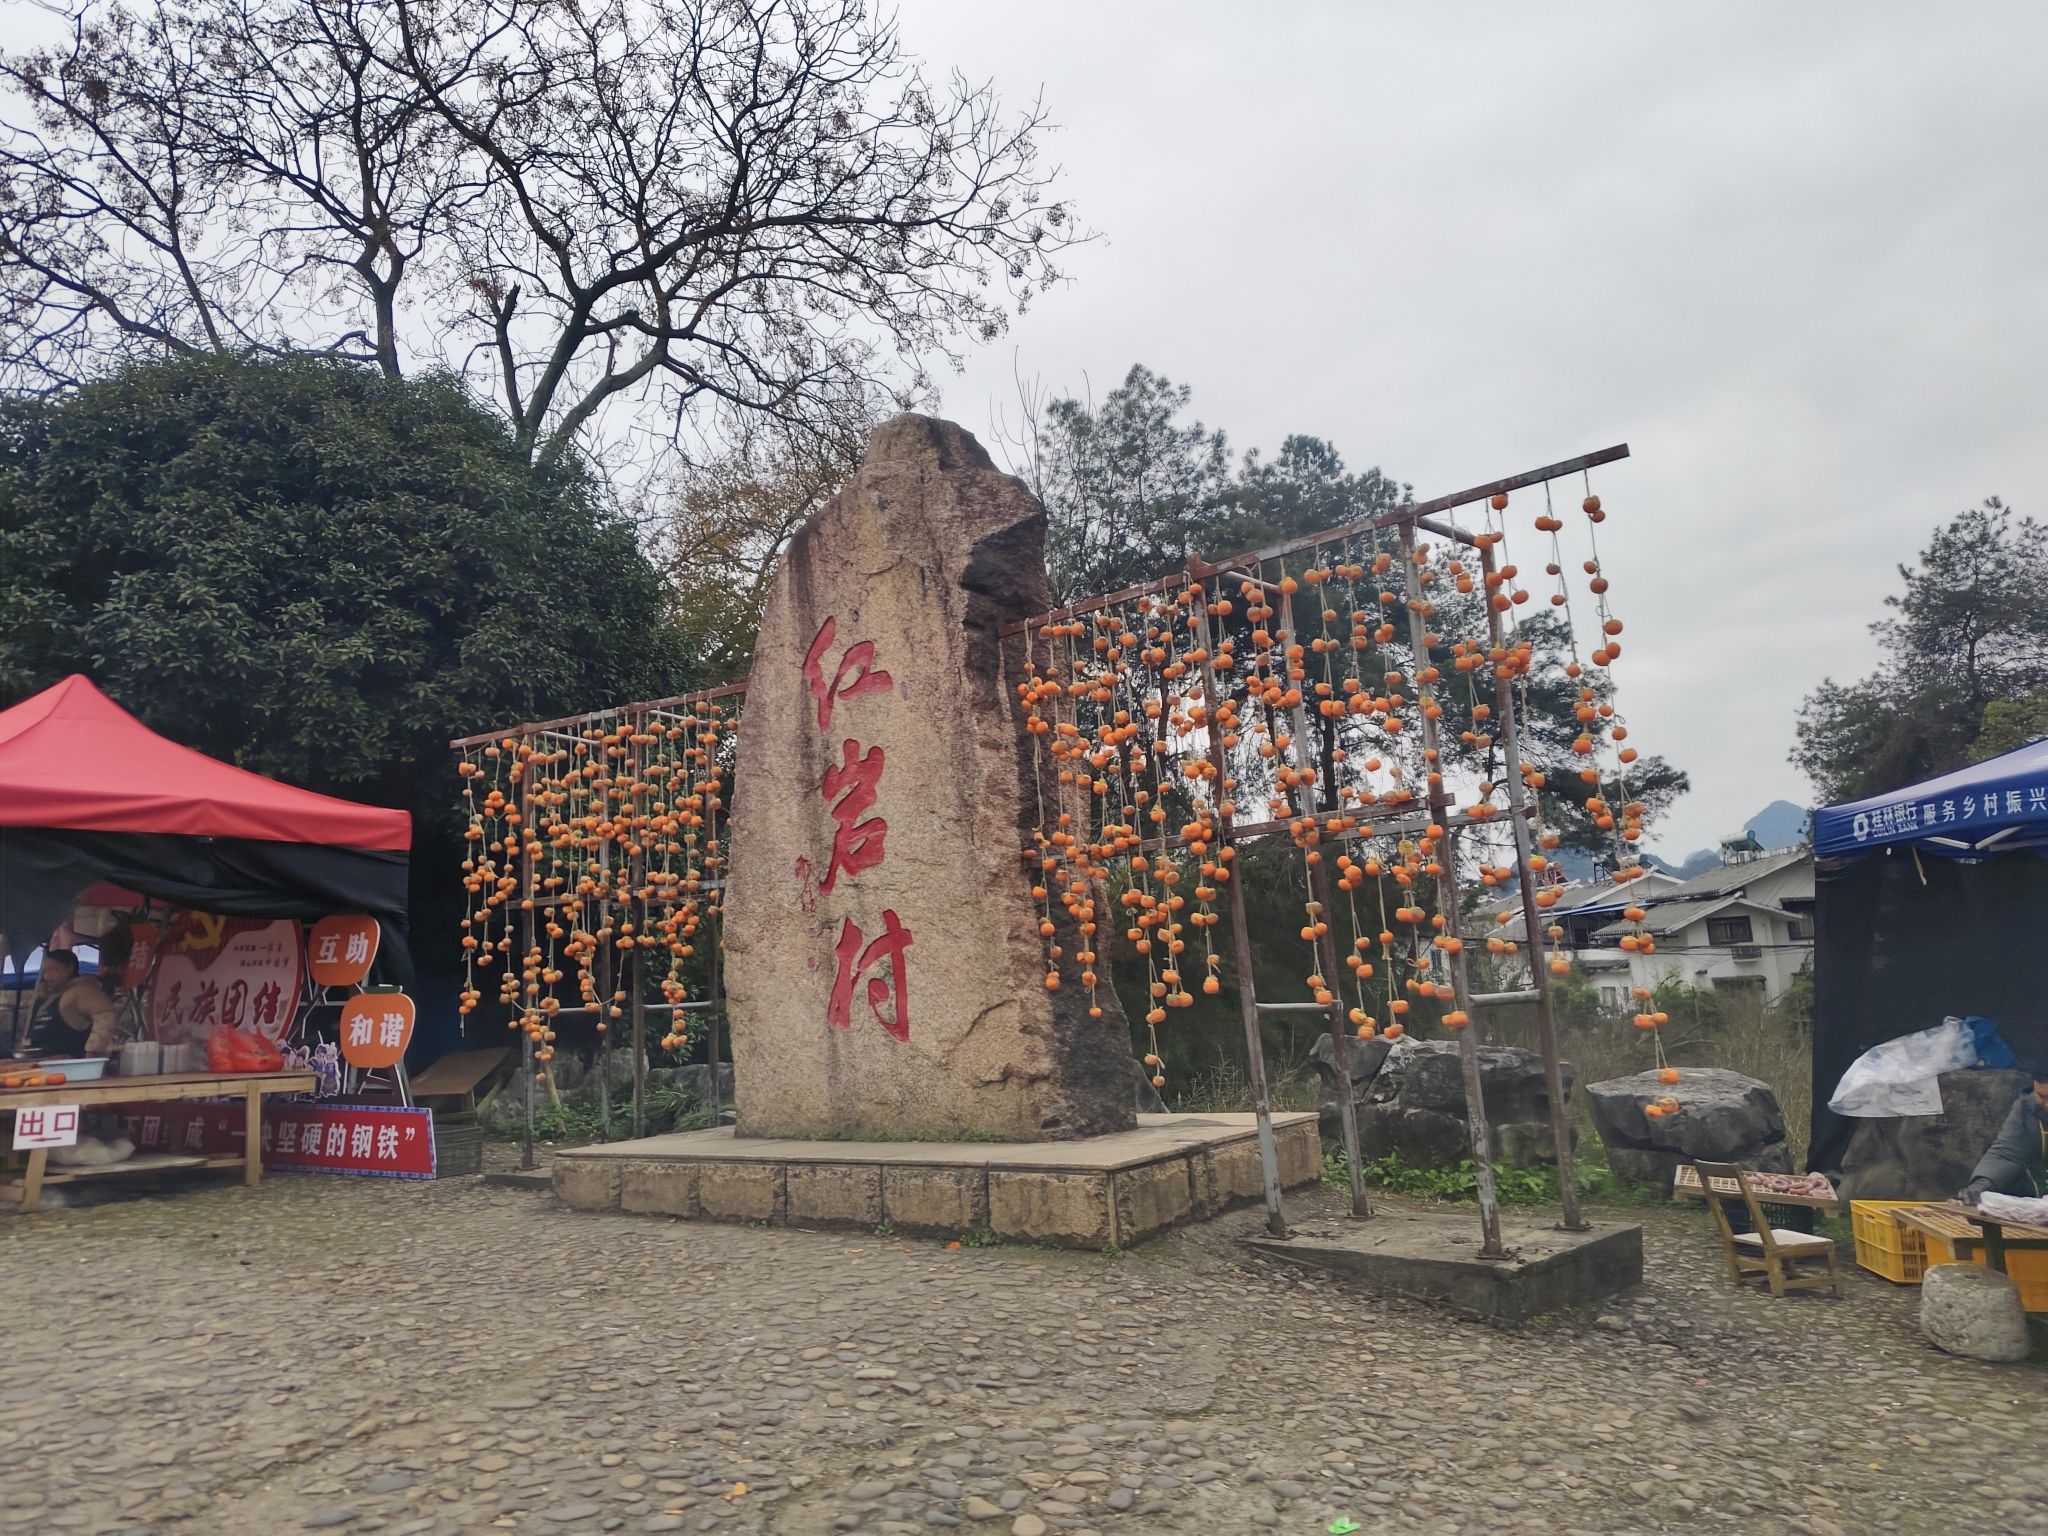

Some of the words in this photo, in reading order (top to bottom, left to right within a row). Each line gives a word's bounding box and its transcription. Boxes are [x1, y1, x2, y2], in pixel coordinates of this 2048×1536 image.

[1872, 801, 1917, 828] 桂林银行
[1924, 787, 2047, 824] 服务乡村振兴
[803, 616, 913, 1042] 红岩村
[1897, 820, 1919, 833] BANK
[315, 931, 369, 964] 互助
[160, 979, 282, 1027] 民族团结
[348, 1013, 404, 1048] 和谐
[19, 1110, 75, 1137] 出口
